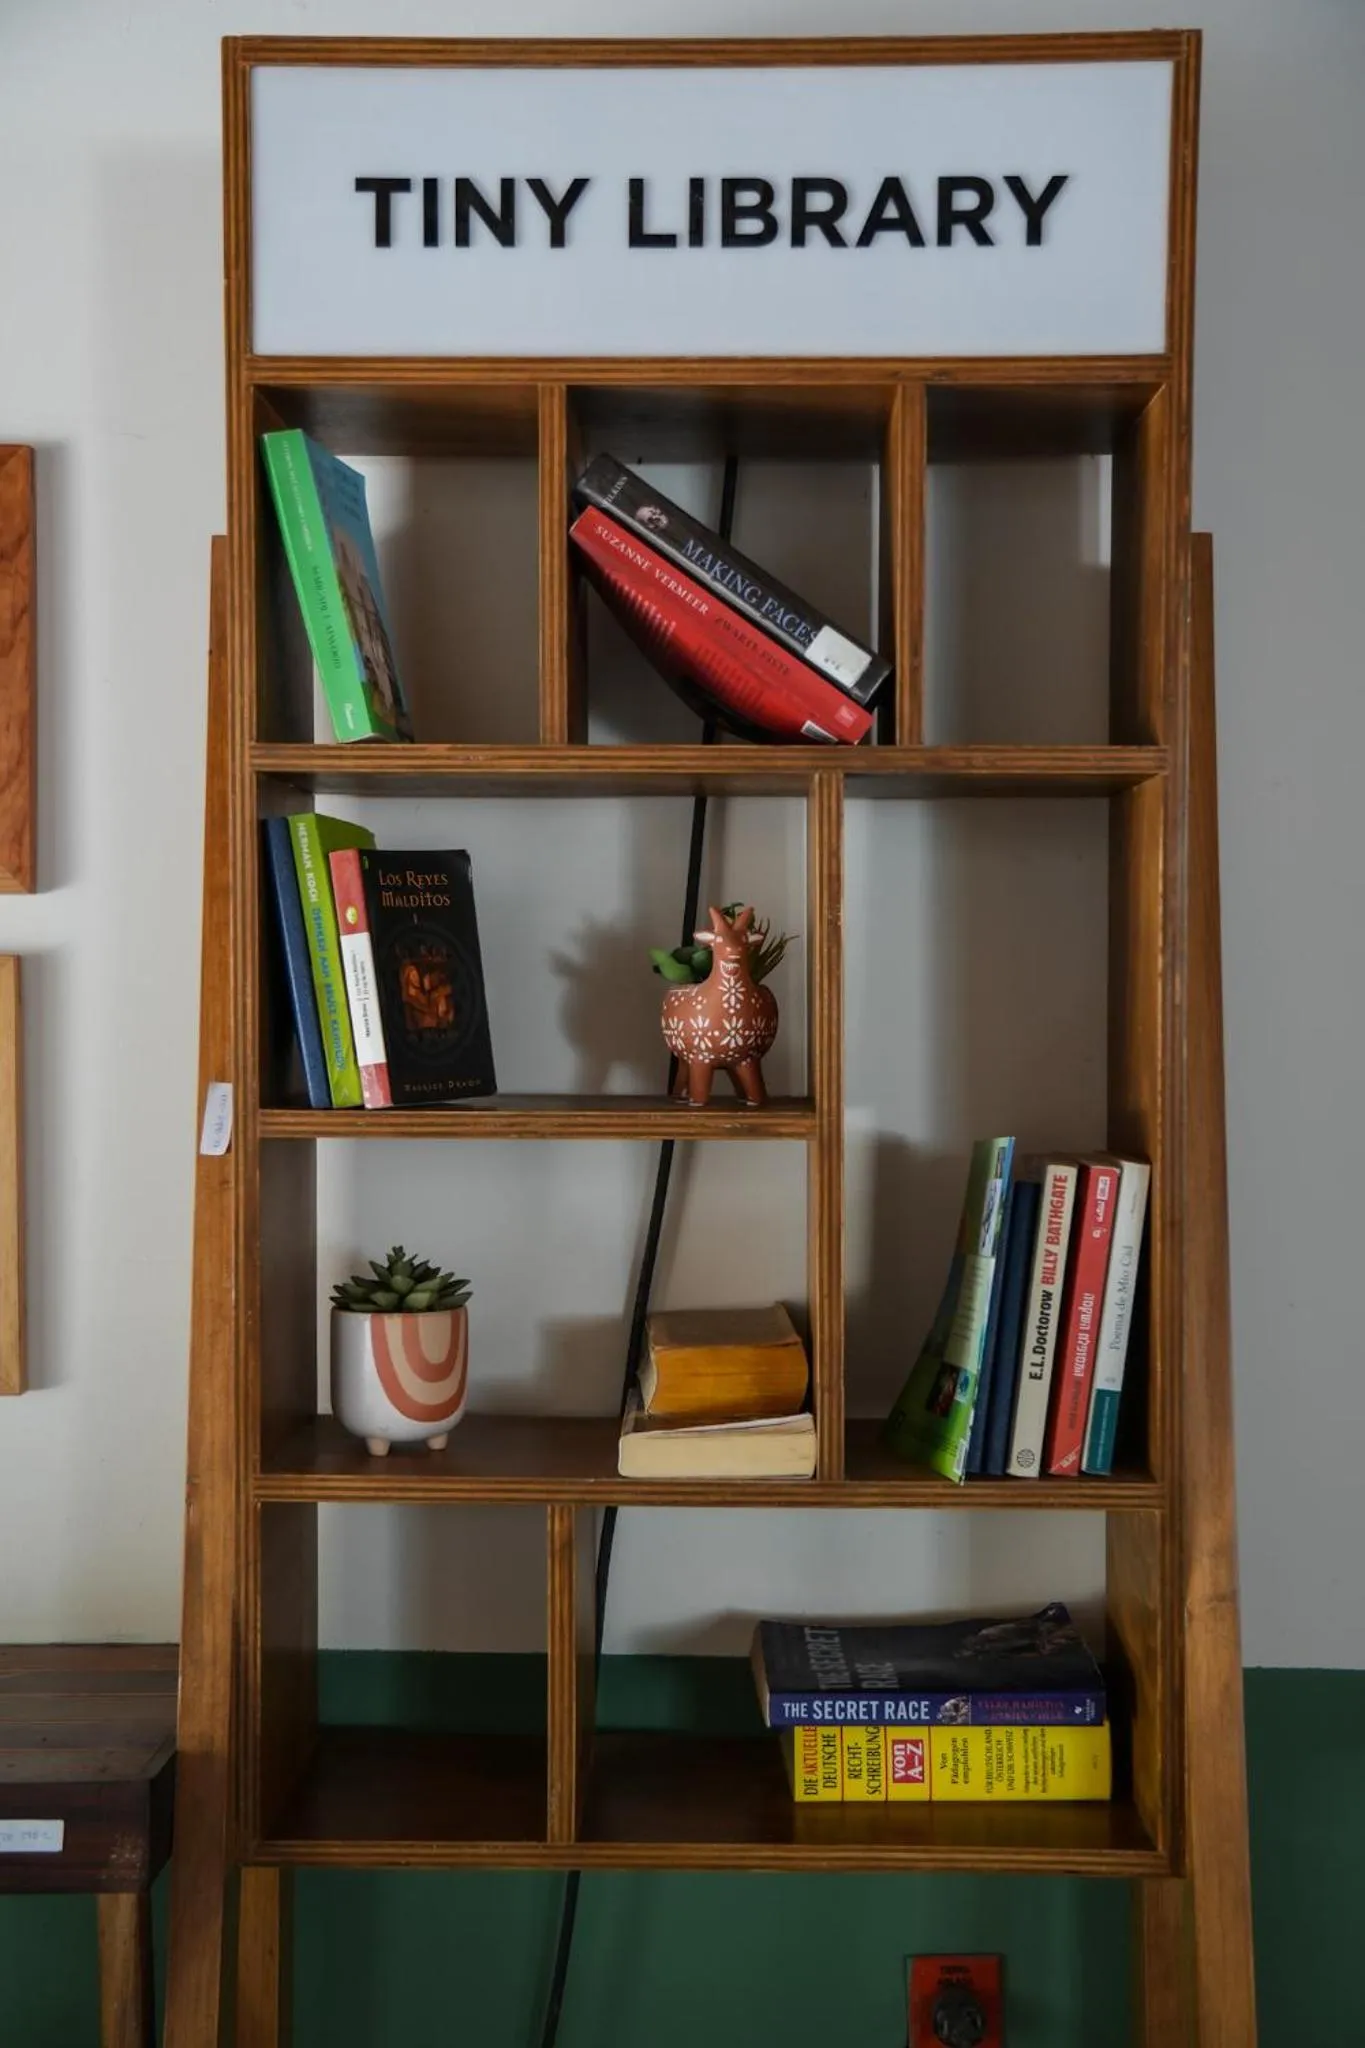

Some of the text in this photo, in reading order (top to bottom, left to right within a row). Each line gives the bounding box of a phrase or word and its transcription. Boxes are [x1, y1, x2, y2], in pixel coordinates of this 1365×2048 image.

[355, 174, 1069, 249] TINY LIBRARY
[594, 524, 652, 571] SUZANNE
[654, 568, 709, 616] VERMEER
[681, 538, 818, 648] MAKING FACES
[296, 822, 312, 870] HERMAN
[306, 872, 319, 903] KOCH
[1046, 1174, 1068, 1246] BATHGATE
[1040, 1249, 1059, 1286] BILLY
[1109, 1245, 1134, 1351] Poema de Mio Cid
[804, 1626, 849, 1671] SECRET
[782, 1700, 931, 1720] THE SECRET RACE
[803, 1725, 819, 1796] DIE AKTUELLE
[821, 1733, 838, 1789] DEUTSCHE
[847, 1742, 863, 1780] RECHT-
[865, 1725, 882, 1796] SCHREIBUNG
[893, 1744, 907, 1779] von
[940, 1752, 948, 1770] Von
